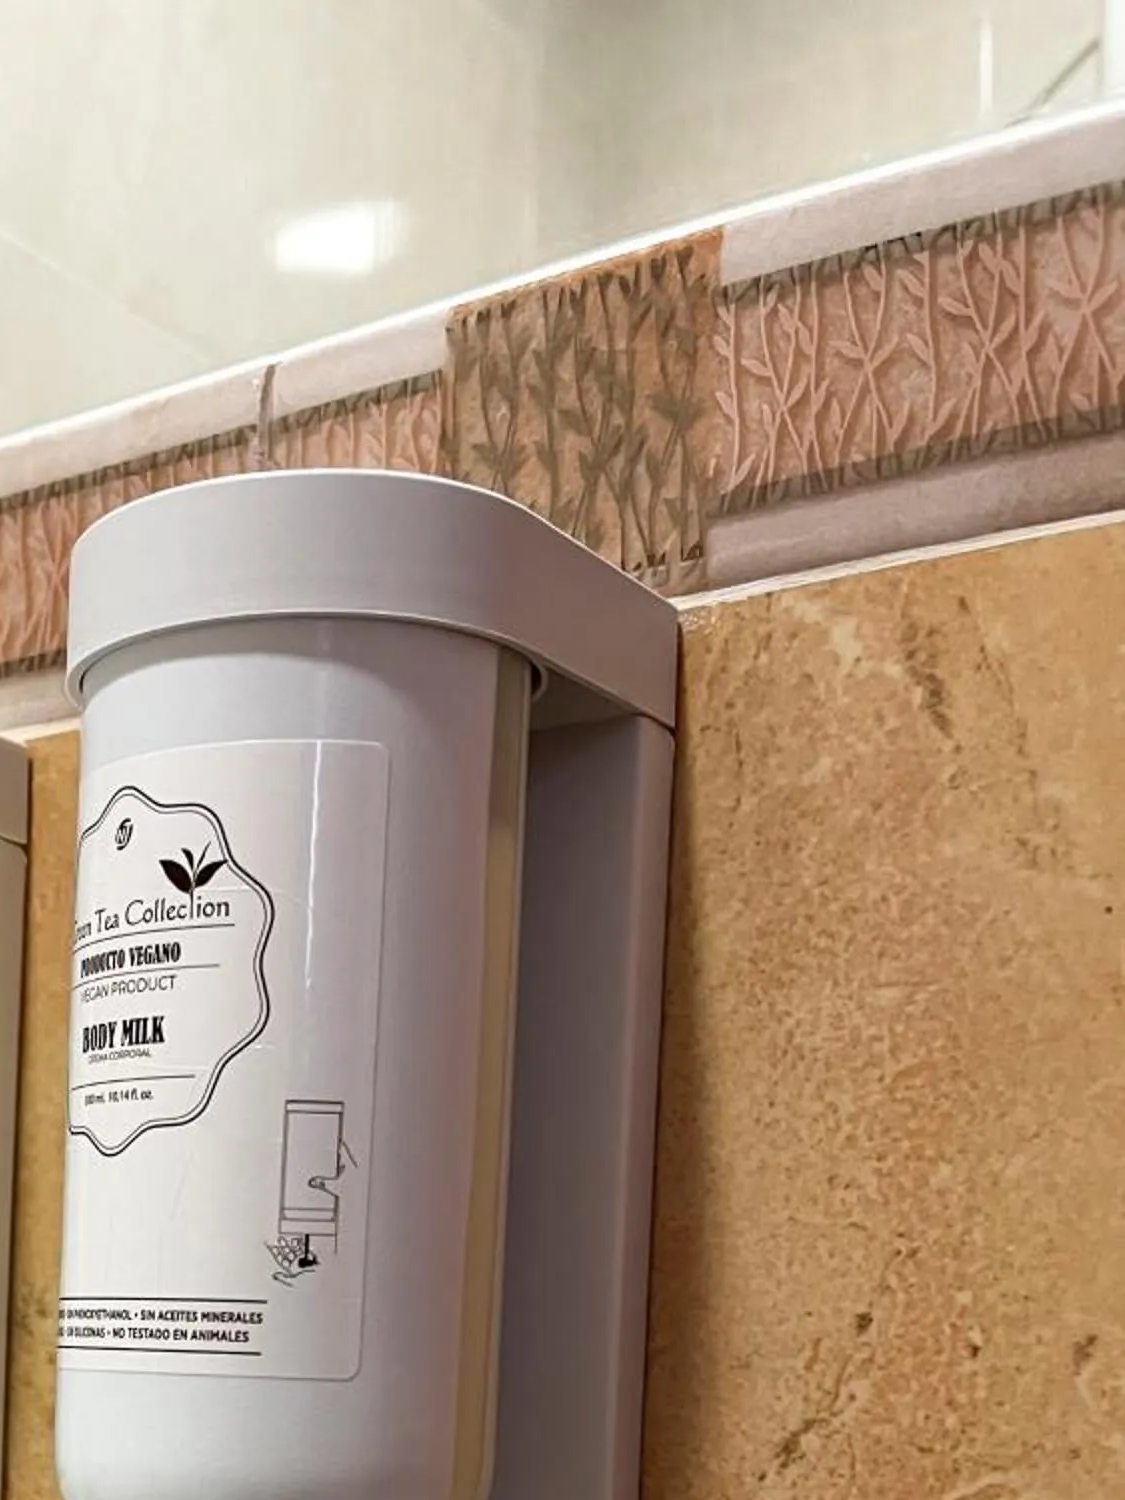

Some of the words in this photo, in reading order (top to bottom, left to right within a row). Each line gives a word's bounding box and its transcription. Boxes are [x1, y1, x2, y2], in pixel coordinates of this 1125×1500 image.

[94, 907, 120, 933] Tea
[125, 896, 230, 926] Collection
[80, 949, 126, 979] PRODUCTO
[129, 941, 182, 967] VEGANO
[111, 974, 178, 997] PRODUCT
[82, 1021, 117, 1054] BODY
[121, 1015, 166, 1046] MILK
[140, 1309, 156, 1321] SIN
[157, 1310, 198, 1323] ACEITES
[200, 1311, 264, 1325] MINERALES
[112, 1327, 126, 1339] NO
[127, 1327, 171, 1341] TESTADO
[172, 1328, 188, 1341] EN
[190, 1329, 250, 1343] ANIMALES
